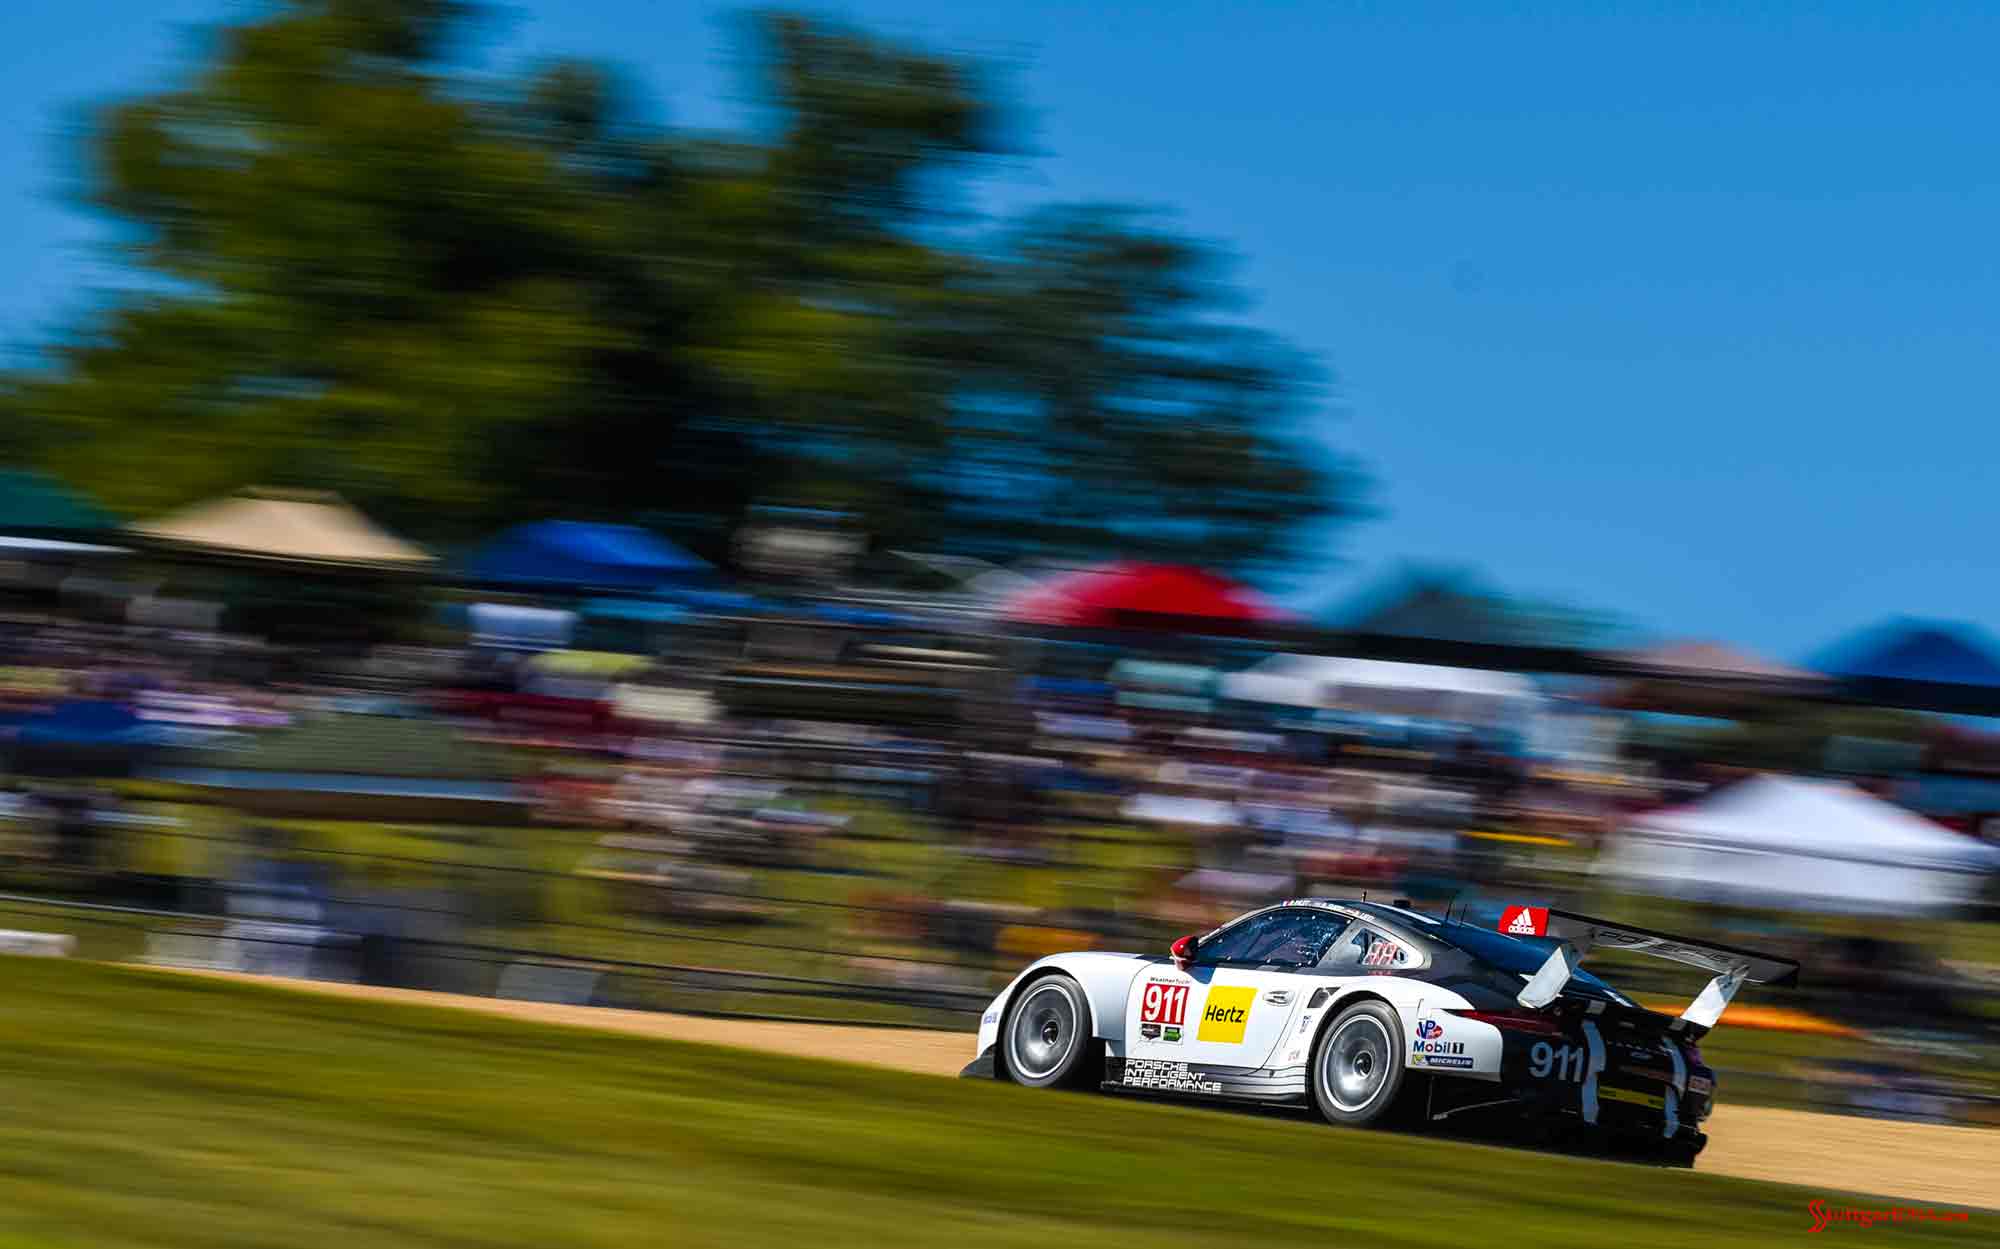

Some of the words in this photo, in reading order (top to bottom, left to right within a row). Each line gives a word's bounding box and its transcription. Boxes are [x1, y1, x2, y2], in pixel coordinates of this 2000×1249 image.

[1508, 924, 1535, 935] adidas
[1144, 985, 1187, 1024] 911
[1205, 1005, 1245, 1023] Hertz
[1418, 1020, 1436, 1039] VP
[1413, 1040, 1450, 1053] Mobil
[1125, 1059, 1188, 1072] PORSCHE
[1429, 1057, 1472, 1066] MICHELIN
[1528, 1042, 1584, 1082] 911
[1124, 1068, 1205, 1081] INTELLIGENT
[1123, 1077, 1222, 1092] PERFORMANCE
